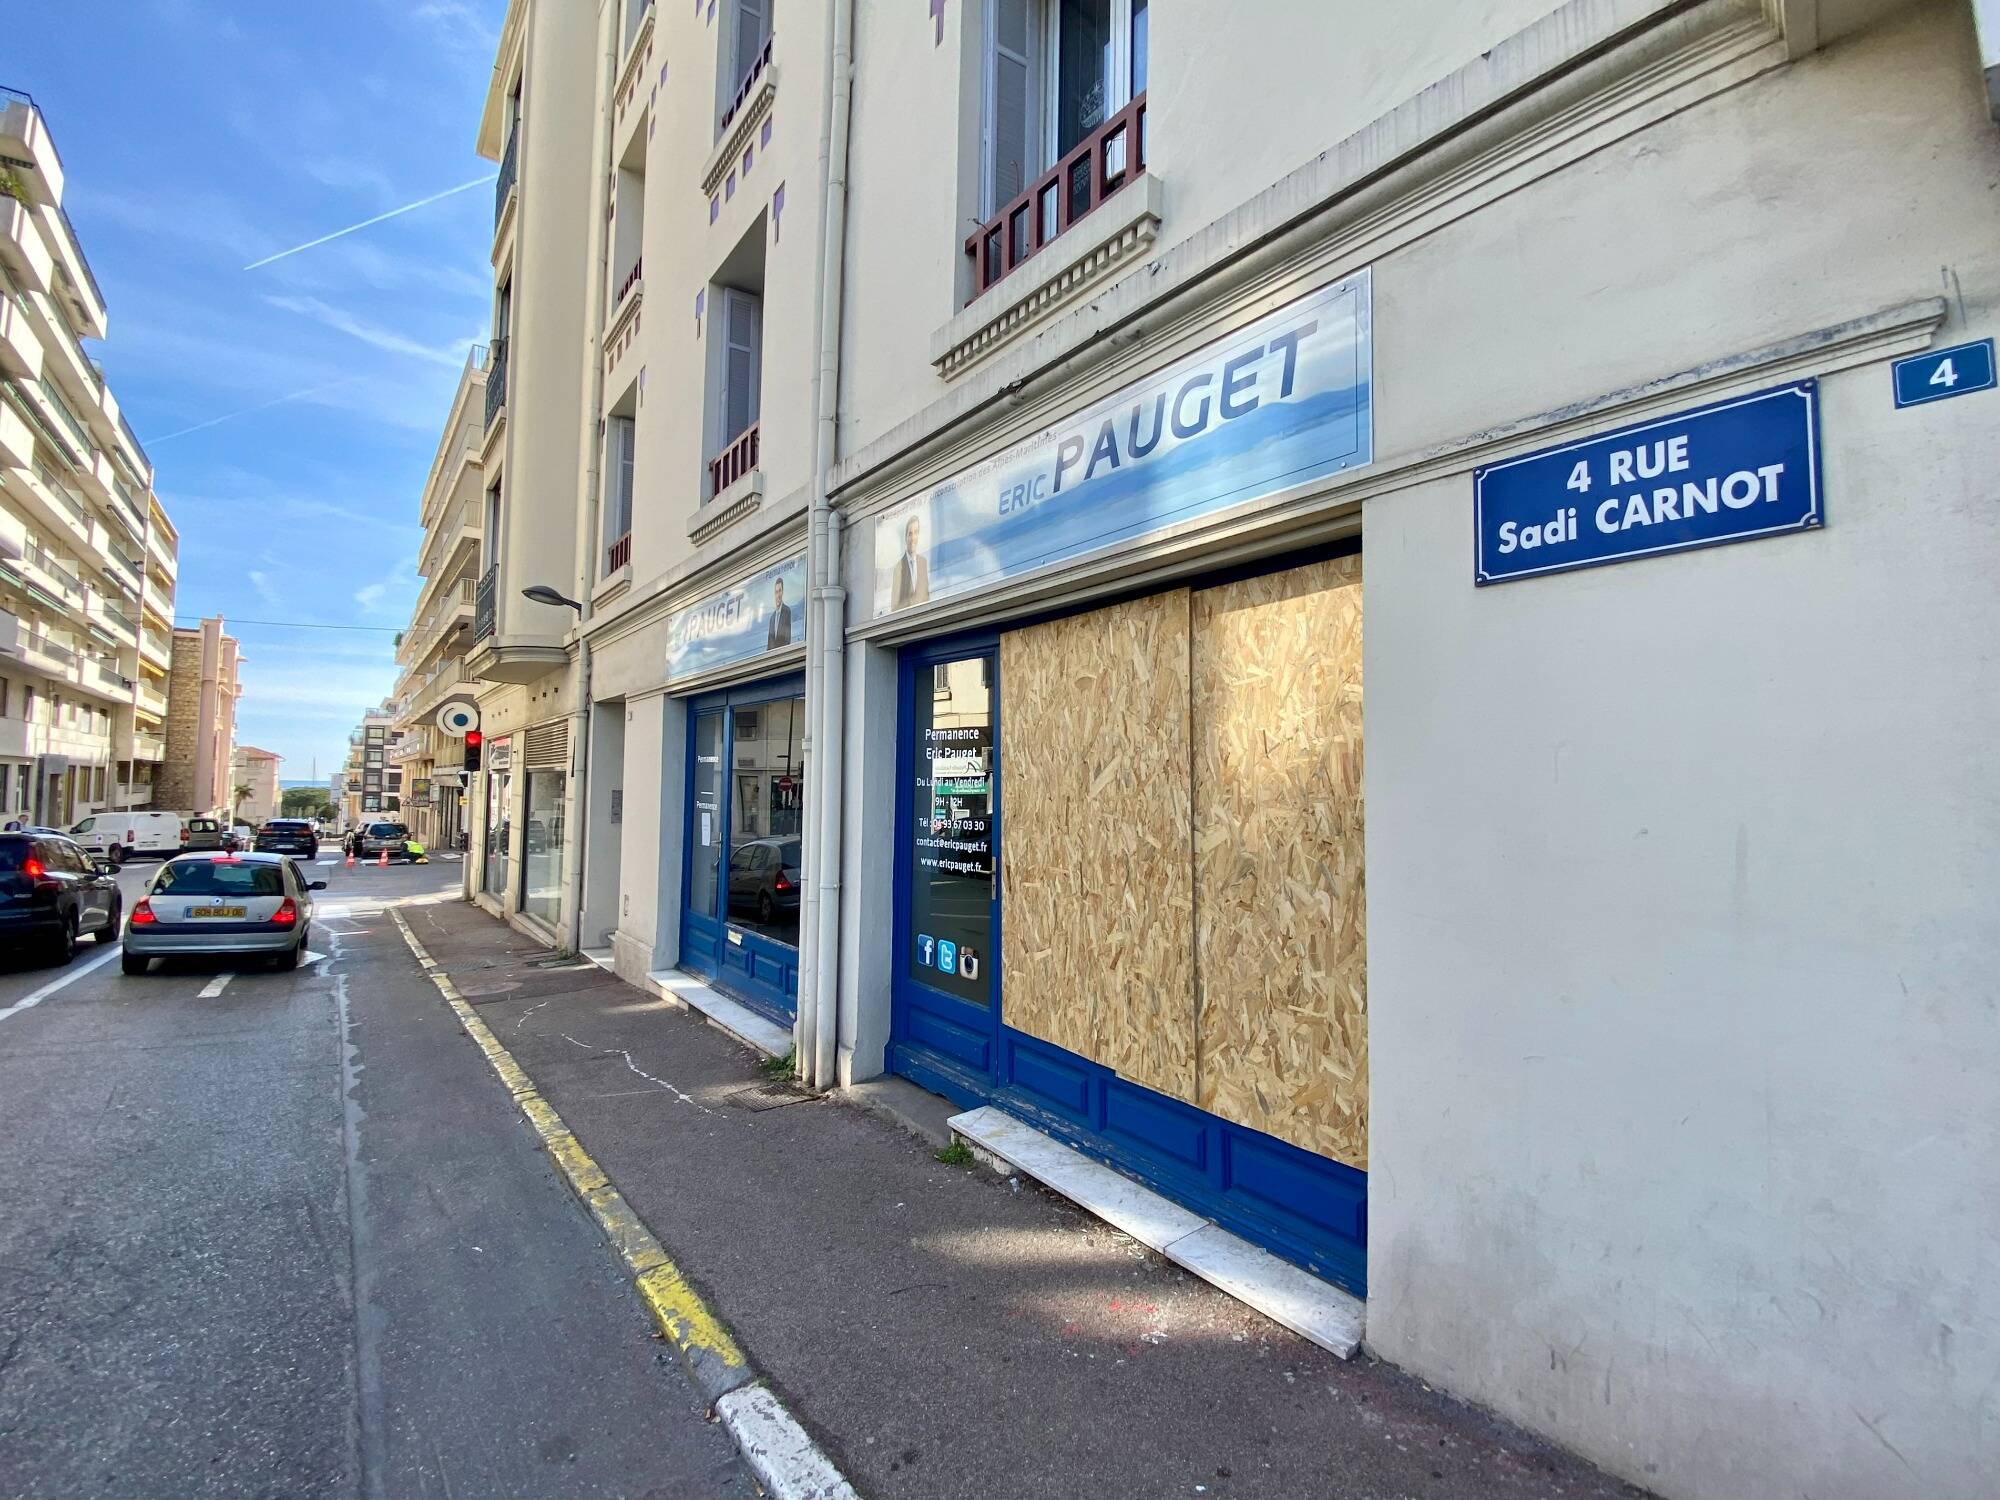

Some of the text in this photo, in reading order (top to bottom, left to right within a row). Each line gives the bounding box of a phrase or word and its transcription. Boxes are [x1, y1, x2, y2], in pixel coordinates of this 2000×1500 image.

[1929, 358, 1958, 387] 4
[998, 319, 1319, 515] ERIC PAUGET
[1566, 435, 1689, 493] 4 RUE
[1498, 463, 1784, 554] Sadi CARNOT
[925, 728, 980, 741] Permanence
[926, 747, 977, 760] Eric Pauget
[916, 777, 926, 787] Du
[945, 779, 953, 787] au
[953, 777, 985, 788] Vendredi
[935, 796, 945, 807] 9H
[943, 819, 952, 829] 93
[953, 819, 962, 830] 67
[962, 820, 973, 831] 03
[973, 821, 985, 831] 30
[916, 838, 988, 853] contact@ericpauget.fr
[920, 857, 982, 873] www.ericpauget.fr
